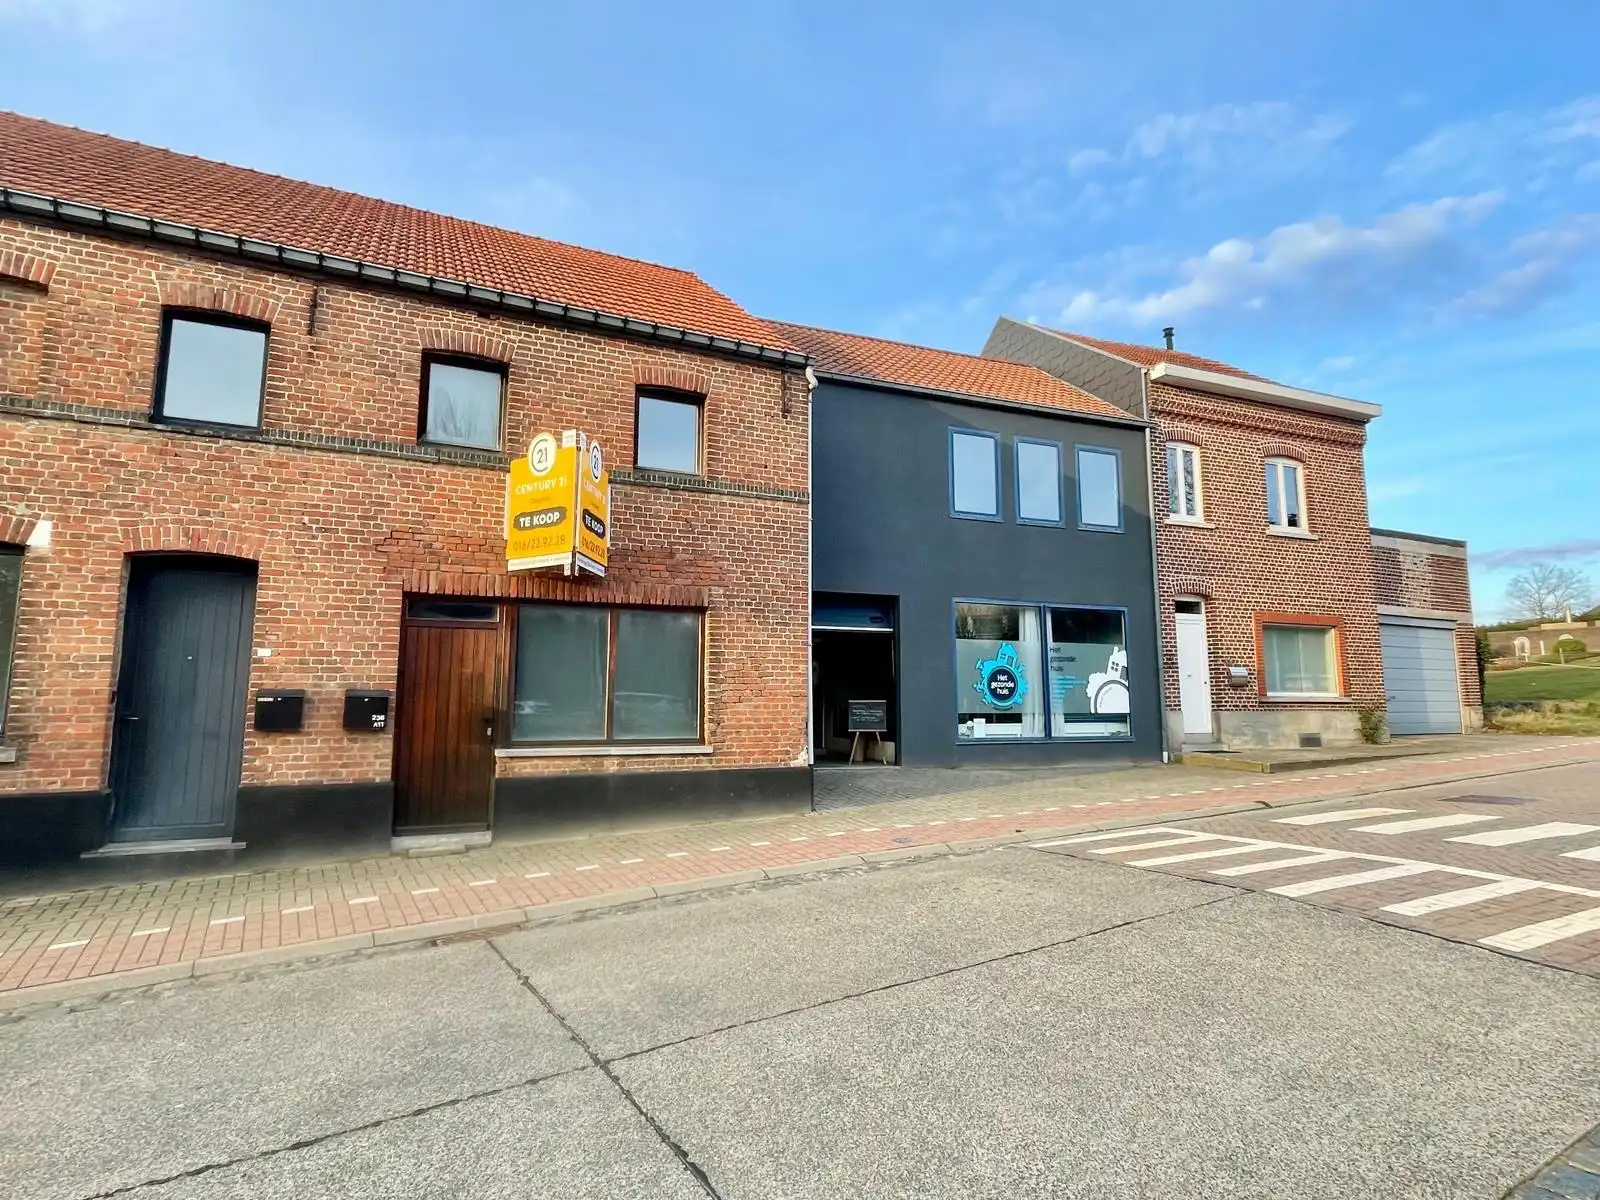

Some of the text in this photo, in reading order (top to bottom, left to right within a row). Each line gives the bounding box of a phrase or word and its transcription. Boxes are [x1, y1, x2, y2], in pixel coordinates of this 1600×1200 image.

[515, 478, 557, 496] CENTURY
[519, 511, 560, 528] TE KOOP
[585, 514, 604, 535] TE KOOP
[990, 681, 1015, 689] gezonde
